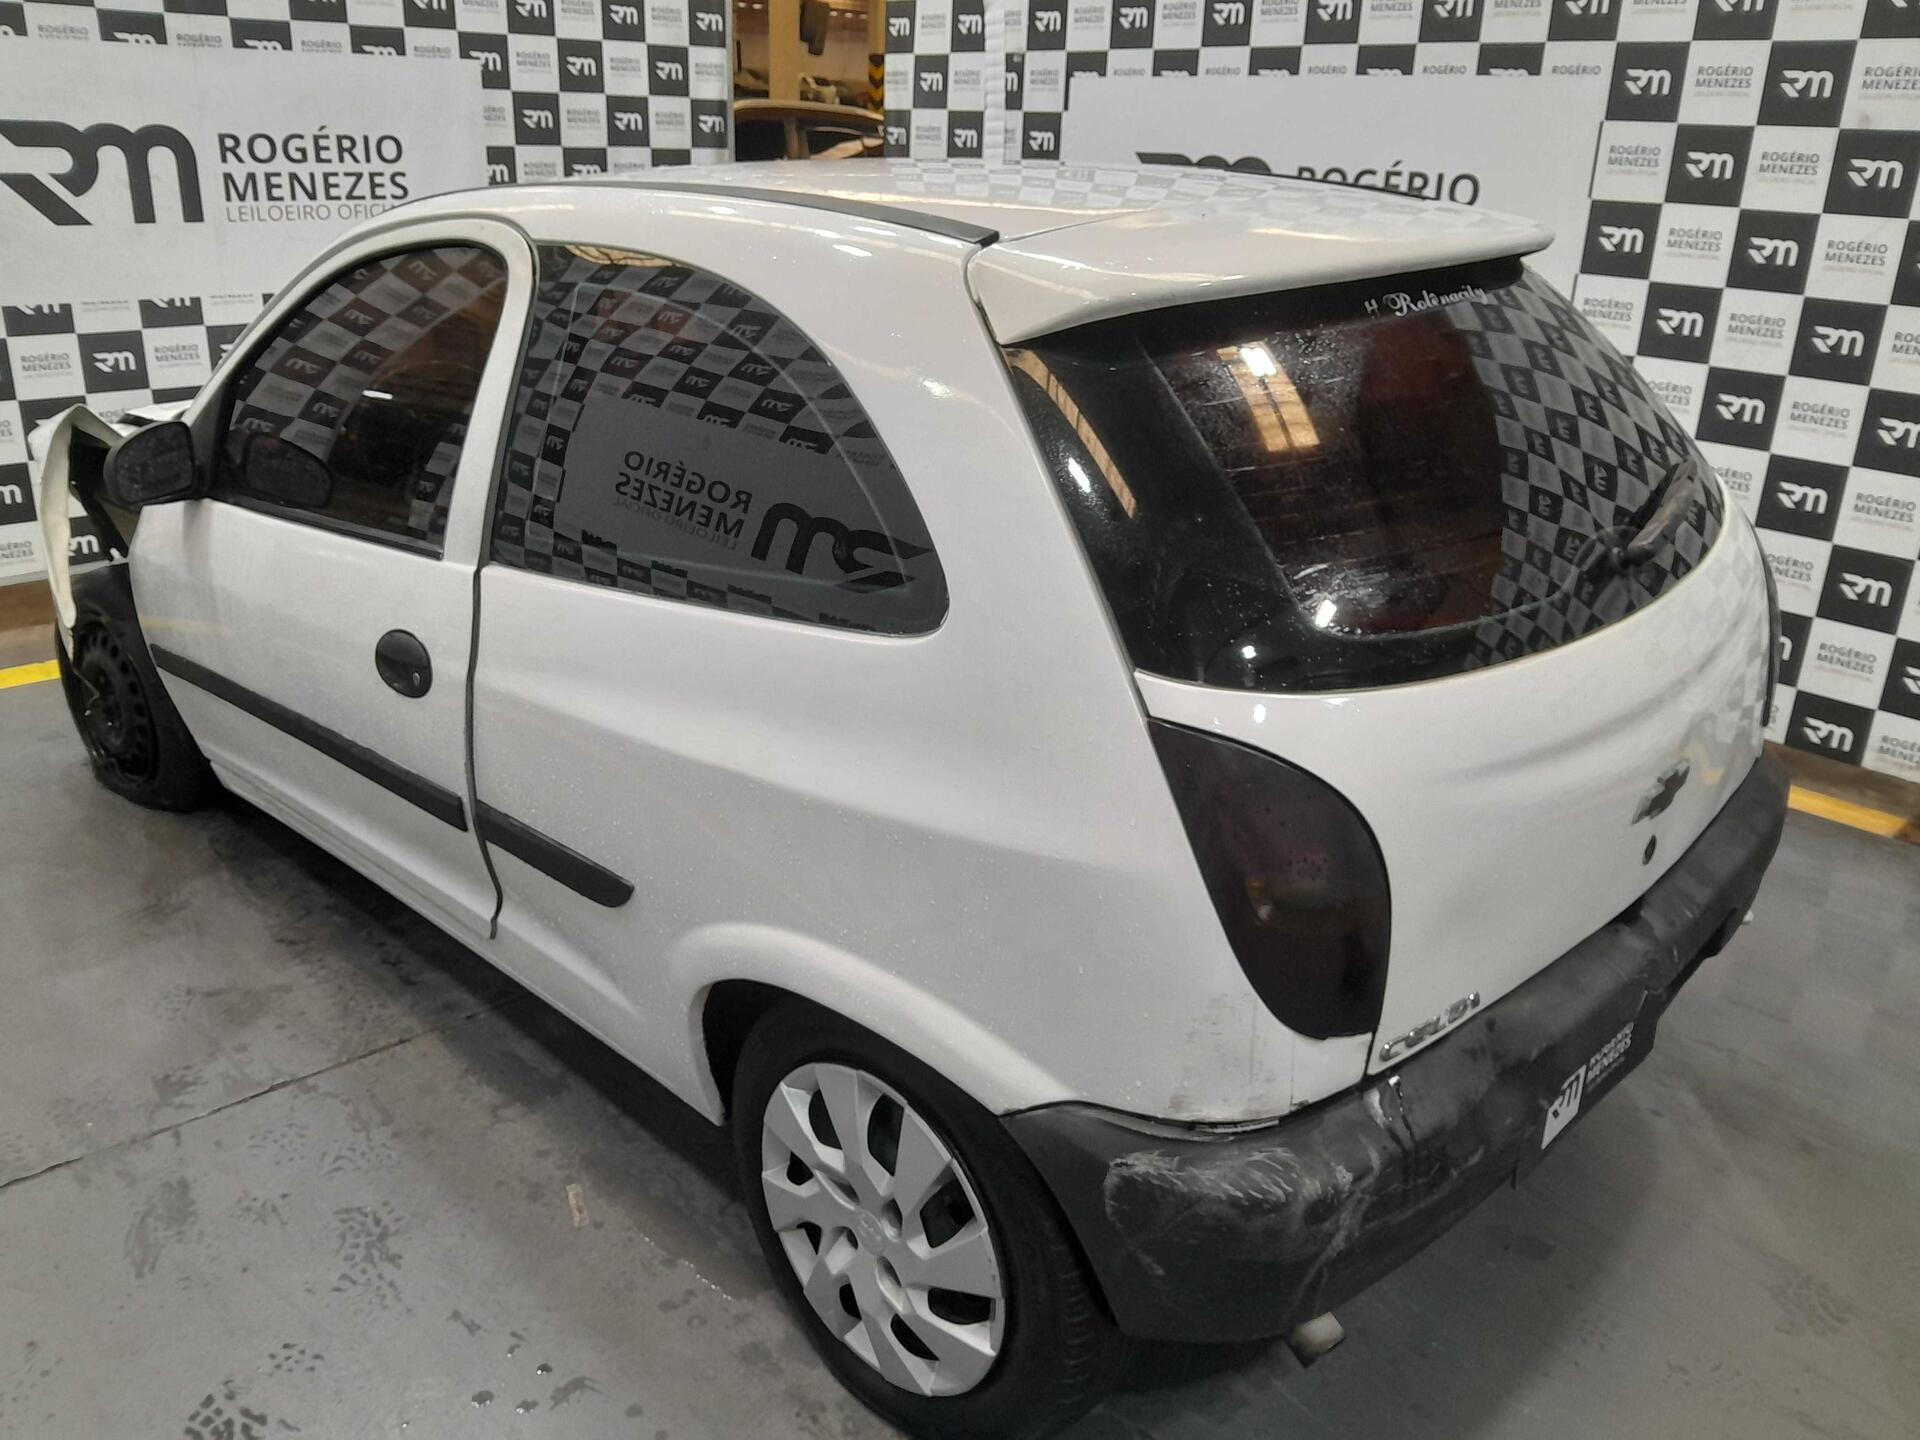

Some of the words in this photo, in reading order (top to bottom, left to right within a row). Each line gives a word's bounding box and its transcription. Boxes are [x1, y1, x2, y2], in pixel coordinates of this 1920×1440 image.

[1864, 64, 1920, 77] ROGÉRI
[1862, 79, 1920, 90] MENEZE
[218, 126, 403, 164] ROGÉRIO
[222, 170, 408, 202] MENEZES
[226, 204, 330, 222] LEILOEIRO
[338, 204, 396, 219] OFIC
